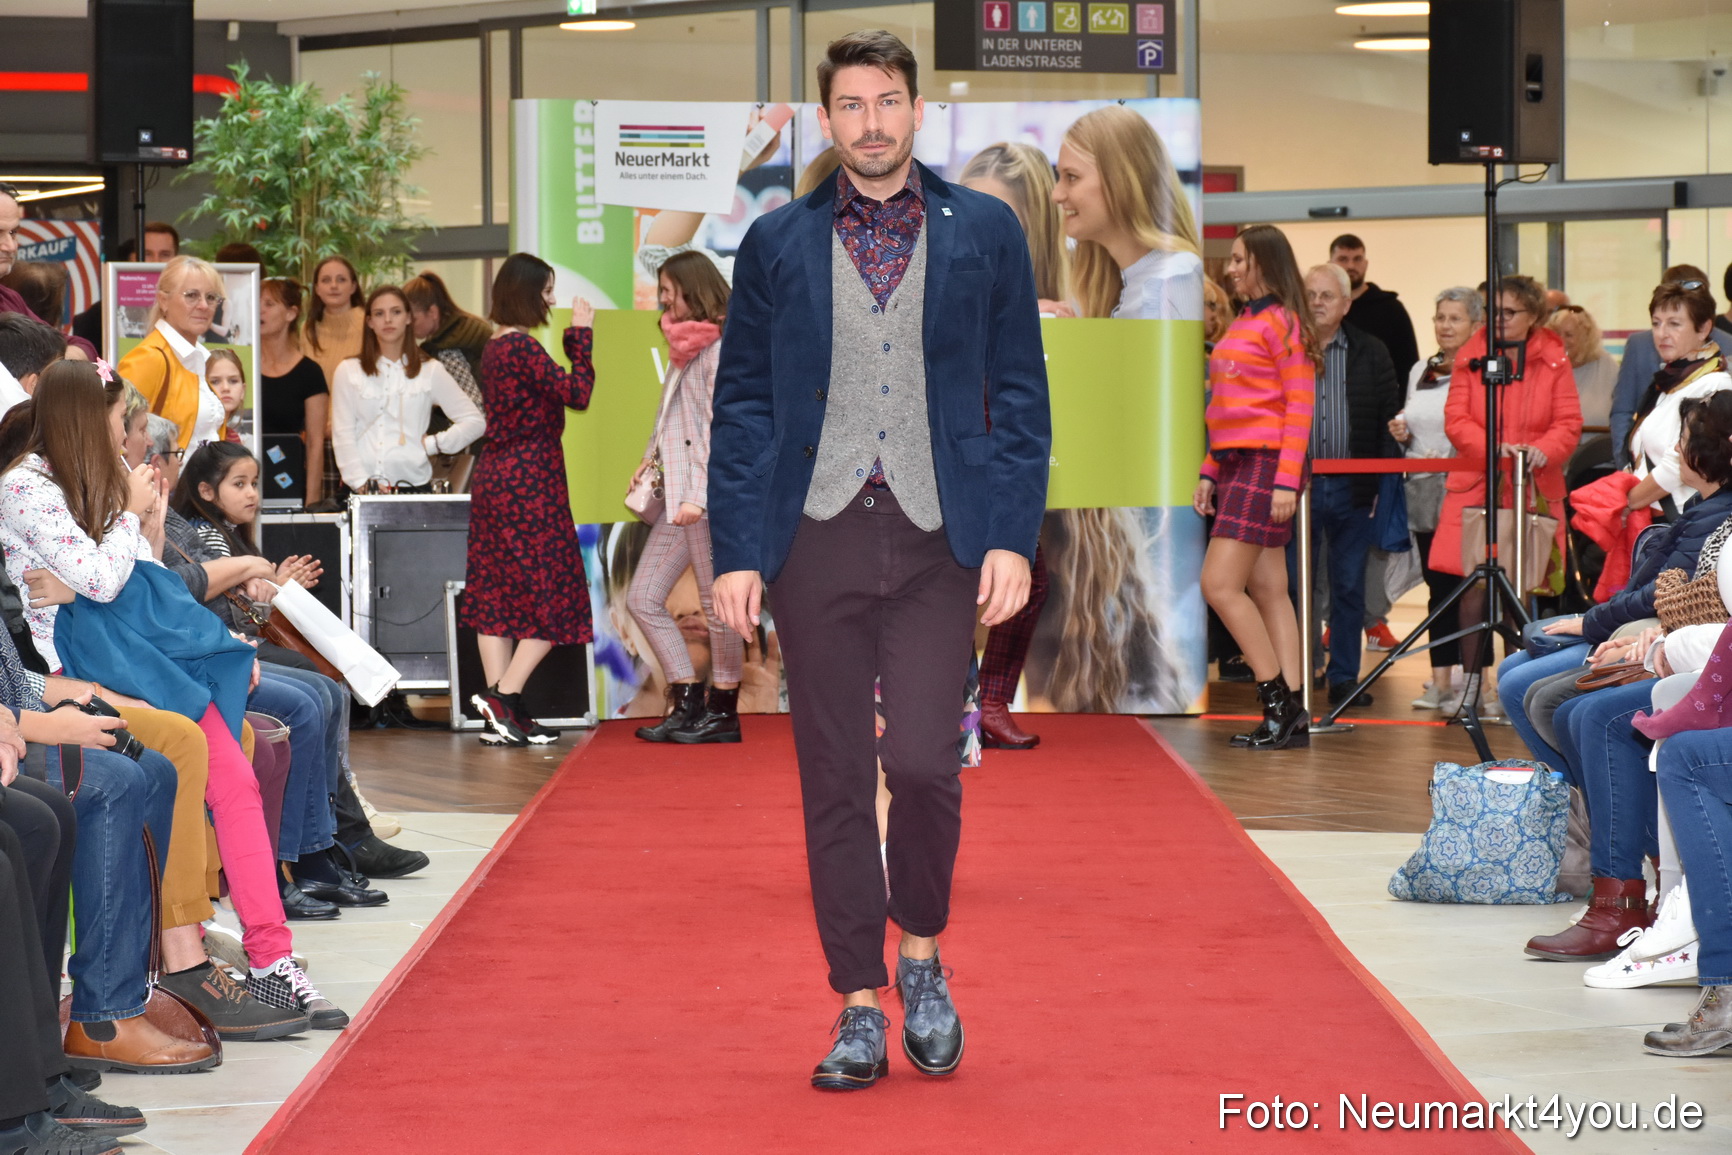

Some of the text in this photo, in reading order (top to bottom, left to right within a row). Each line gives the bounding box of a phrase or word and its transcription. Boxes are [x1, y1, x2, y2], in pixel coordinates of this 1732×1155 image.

[982, 38, 1082, 51] IN DER UNTEREN
[982, 55, 1082, 68] LADENSTRASSE
[1144, 49, 1157, 66] P
[177, 148, 188, 159] 12
[1492, 147, 1503, 157] 12
[614, 151, 710, 167] NeuerMarkt
[573, 99, 605, 244] BUTTER
[619, 171, 708, 180] Alles unter einem Dach.
[17, 239, 70, 260] RKAUF
